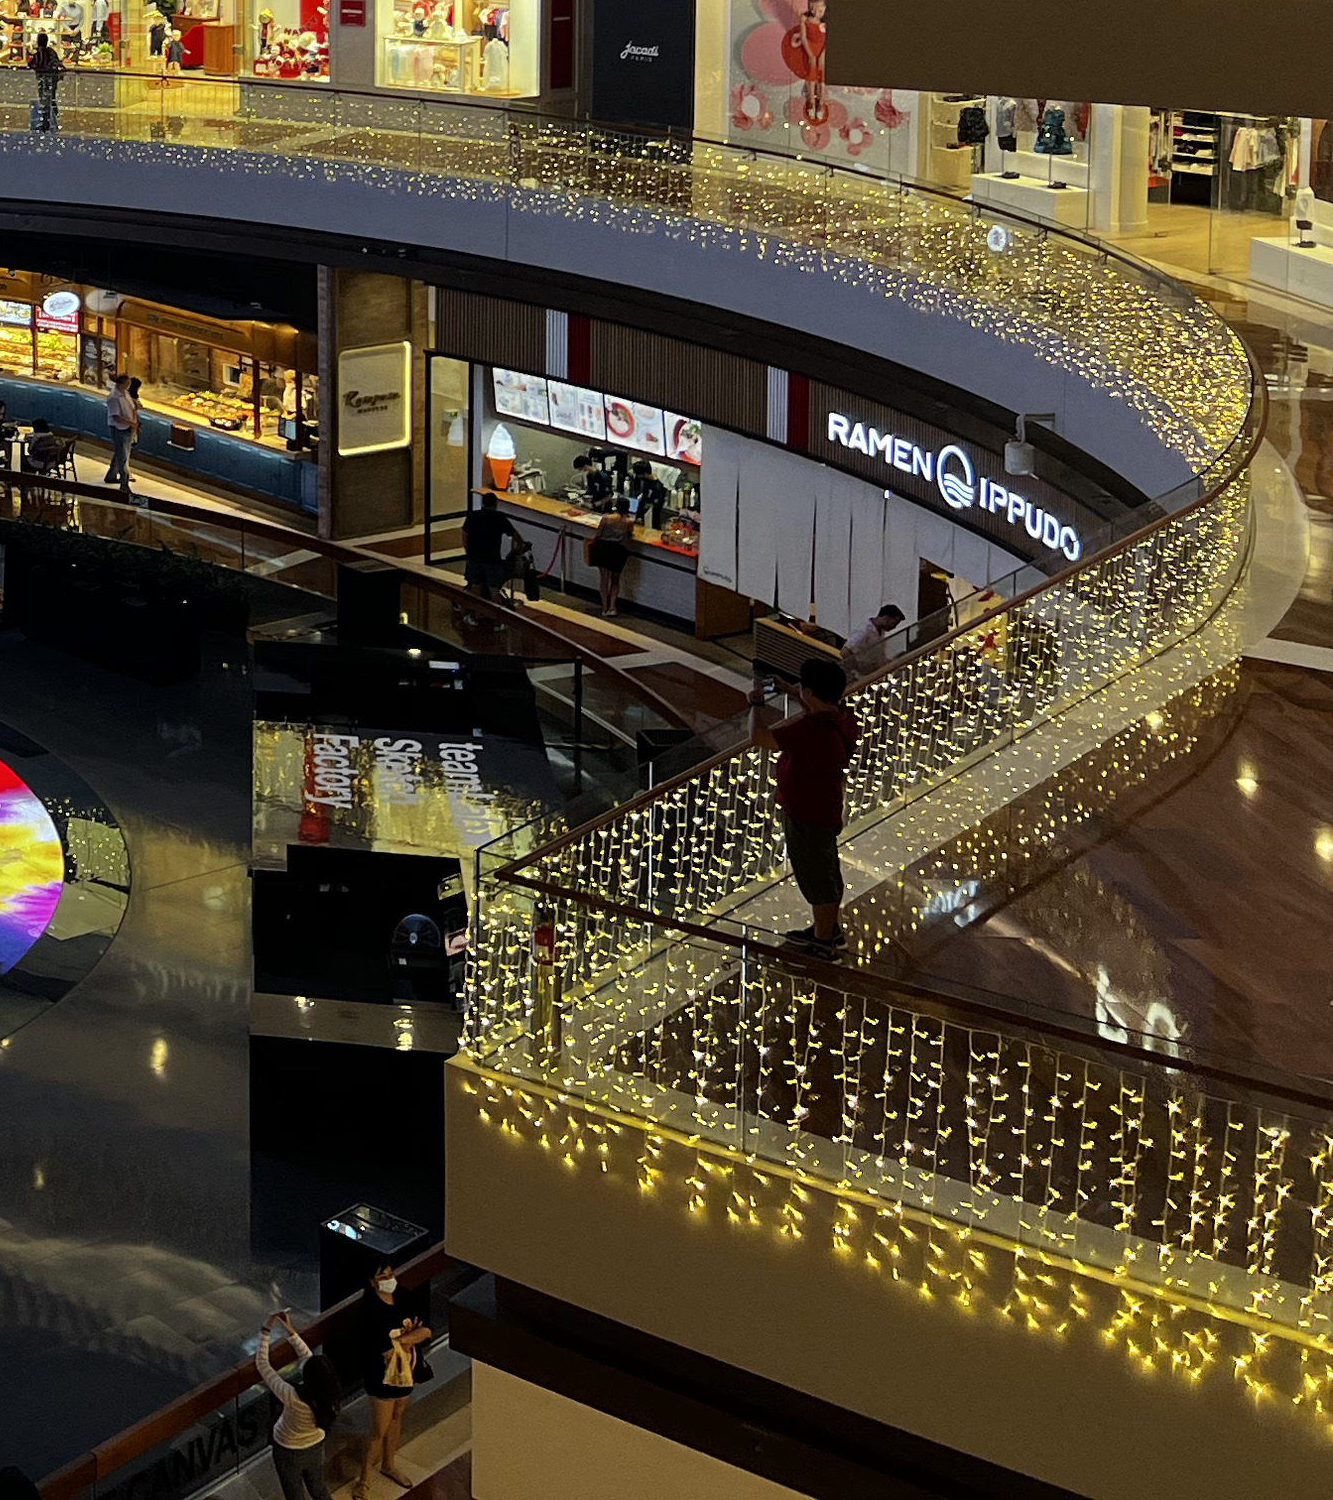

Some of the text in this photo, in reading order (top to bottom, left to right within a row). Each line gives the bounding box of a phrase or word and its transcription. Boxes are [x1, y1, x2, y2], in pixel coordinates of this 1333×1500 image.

[828, 411, 933, 482] RAMEN
[979, 476, 1082, 562] IPPUDO
[306, 733, 360, 810] Factory
[373, 736, 424, 807] Sketch
